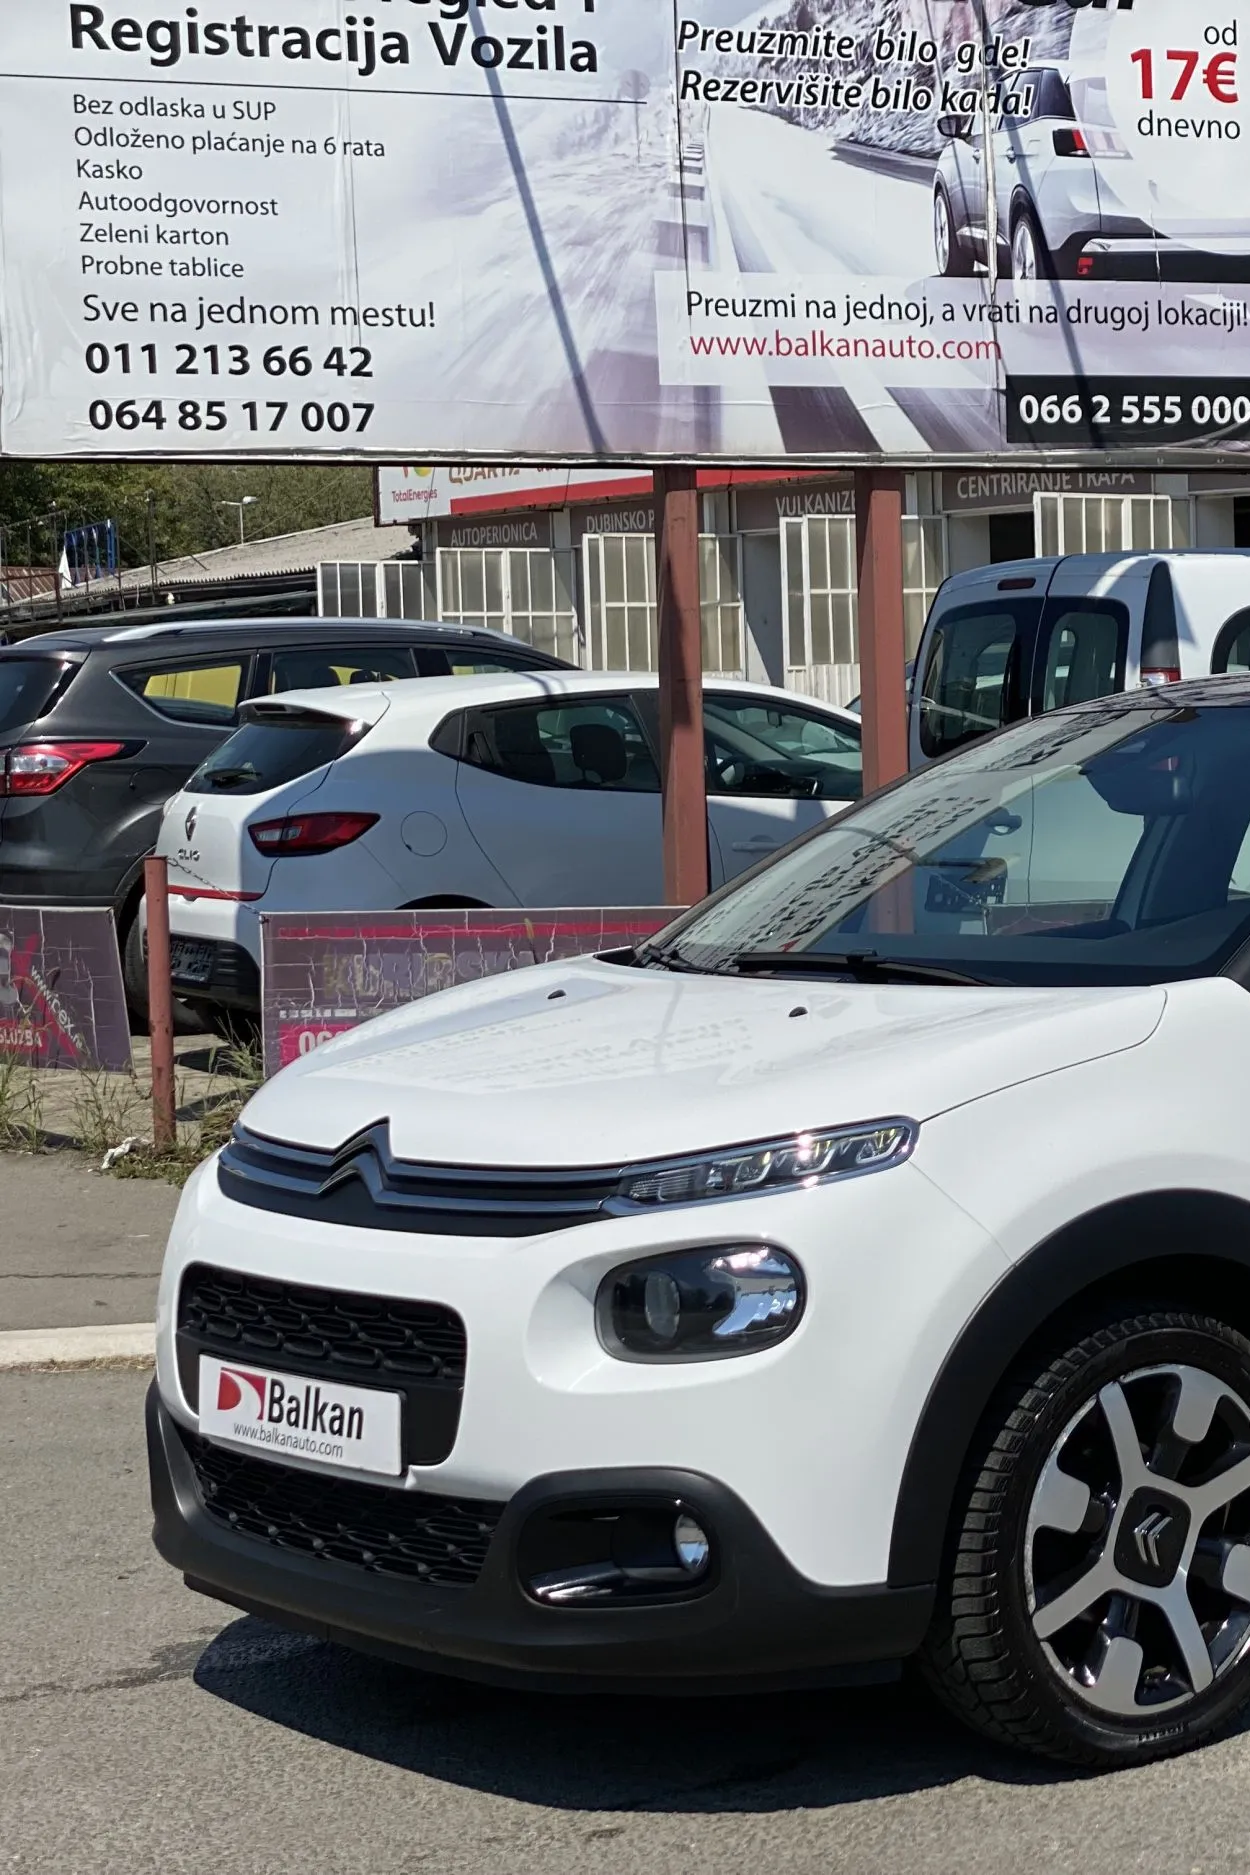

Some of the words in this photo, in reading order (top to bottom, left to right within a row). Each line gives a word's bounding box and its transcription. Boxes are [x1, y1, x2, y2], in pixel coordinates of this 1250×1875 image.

[69, 3, 410, 77] Registracija
[427, 21, 598, 73] Vozila
[678, 20, 855, 61] Preuzmite
[875, 26, 938, 66] bilo
[956, 36, 1032, 74] gde!
[1203, 19, 1238, 46] od
[1130, 48, 1240, 104] 17€
[73, 94, 113, 117] Bez
[119, 97, 206, 120] odlaska
[213, 104, 226, 120] u
[232, 101, 277, 121] SUP
[680, 68, 862, 112] Rezervišite
[870, 78, 933, 112] bilo
[940, 81, 1034, 118] kada!
[1137, 109, 1241, 140] dnevno
[74, 127, 185, 151] Odloženo
[191, 130, 285, 157] plaćanje
[291, 138, 318, 156] na
[323, 136, 337, 156] 6
[343, 138, 386, 157] rata
[75, 159, 143, 181] Kasko
[78, 192, 279, 218] Autoodgovornost
[80, 223, 149, 246] Zeleni
[156, 225, 230, 247] karton
[81, 255, 163, 278] Probne
[169, 256, 245, 279] tablice
[82, 294, 139, 323] Sve
[149, 302, 188, 324] na
[195, 295, 320, 331] jednom
[330, 301, 436, 328] mestu!
[686, 290, 796, 321] Preuzmi
[805, 298, 837, 320] na
[842, 294, 935, 327] jednoj,
[941, 304, 956, 323] a
[963, 298, 1022, 325] vrati
[1028, 303, 1059, 325] na
[1065, 298, 1151, 334] drugoj
[1156, 299, 1249, 328] lokaciji!
[85, 342, 159, 376] 011
[175, 343, 252, 377] 213
[263, 344, 313, 377] 66
[323, 345, 375, 378] 42
[690, 331, 1002, 361] www.balkanauto.com
[88, 399, 168, 432] 064
[177, 399, 229, 432] 85
[241, 400, 289, 433] 17
[300, 401, 376, 433] 007
[1018, 394, 1083, 426] 066
[1091, 394, 1111, 425] 2
[1119, 394, 1184, 426] 555
[391, 487, 438, 503] TotalEnergies
[956, 472, 1072, 499] CENTRIRANJE
[450, 521, 538, 547] AUTOPERIONICA
[586, 510, 647, 533] DUBINSKO
[267, 1377, 365, 1441] Balkan
[232, 1421, 344, 1459] www.balkanauto.com
